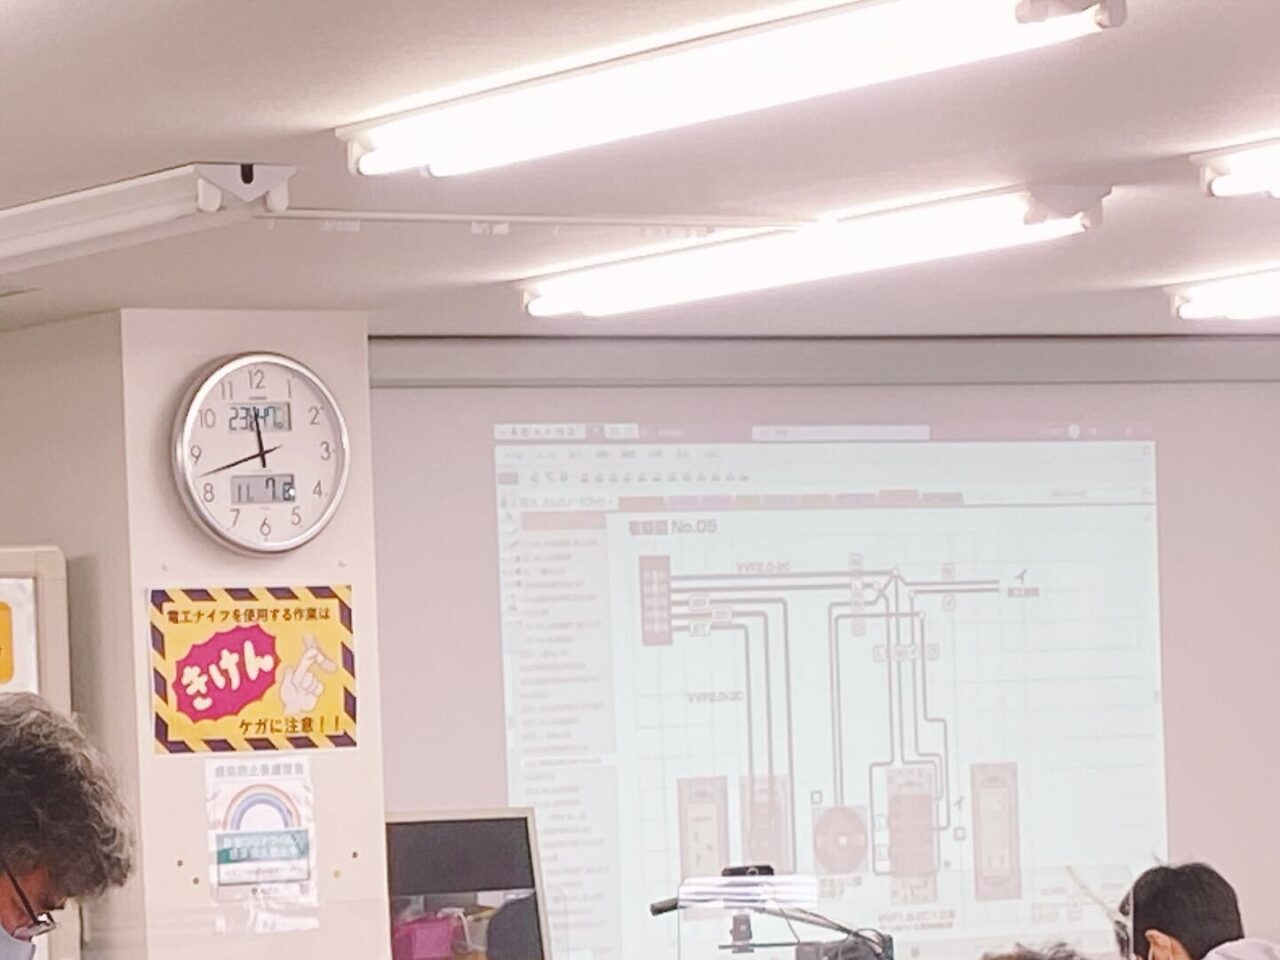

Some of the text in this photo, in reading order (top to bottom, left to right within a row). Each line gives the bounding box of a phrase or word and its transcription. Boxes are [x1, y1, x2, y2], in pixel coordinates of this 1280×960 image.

[248, 369, 264, 389] 12
[221, 381, 233, 400] 11
[200, 408, 216, 428] 10
[308, 407, 320, 425] 2
[190, 446, 202, 464] 9
[320, 441, 331, 460] 3
[203, 483, 214, 502] 8
[313, 481, 323, 497] 4
[230, 509, 241, 527] 7
[291, 506, 302, 525] 5
[260, 517, 271, 534] 6
[168, 608, 331, 625] 電工ナイフを使用する作業は
[181, 639, 275, 711] きけん
